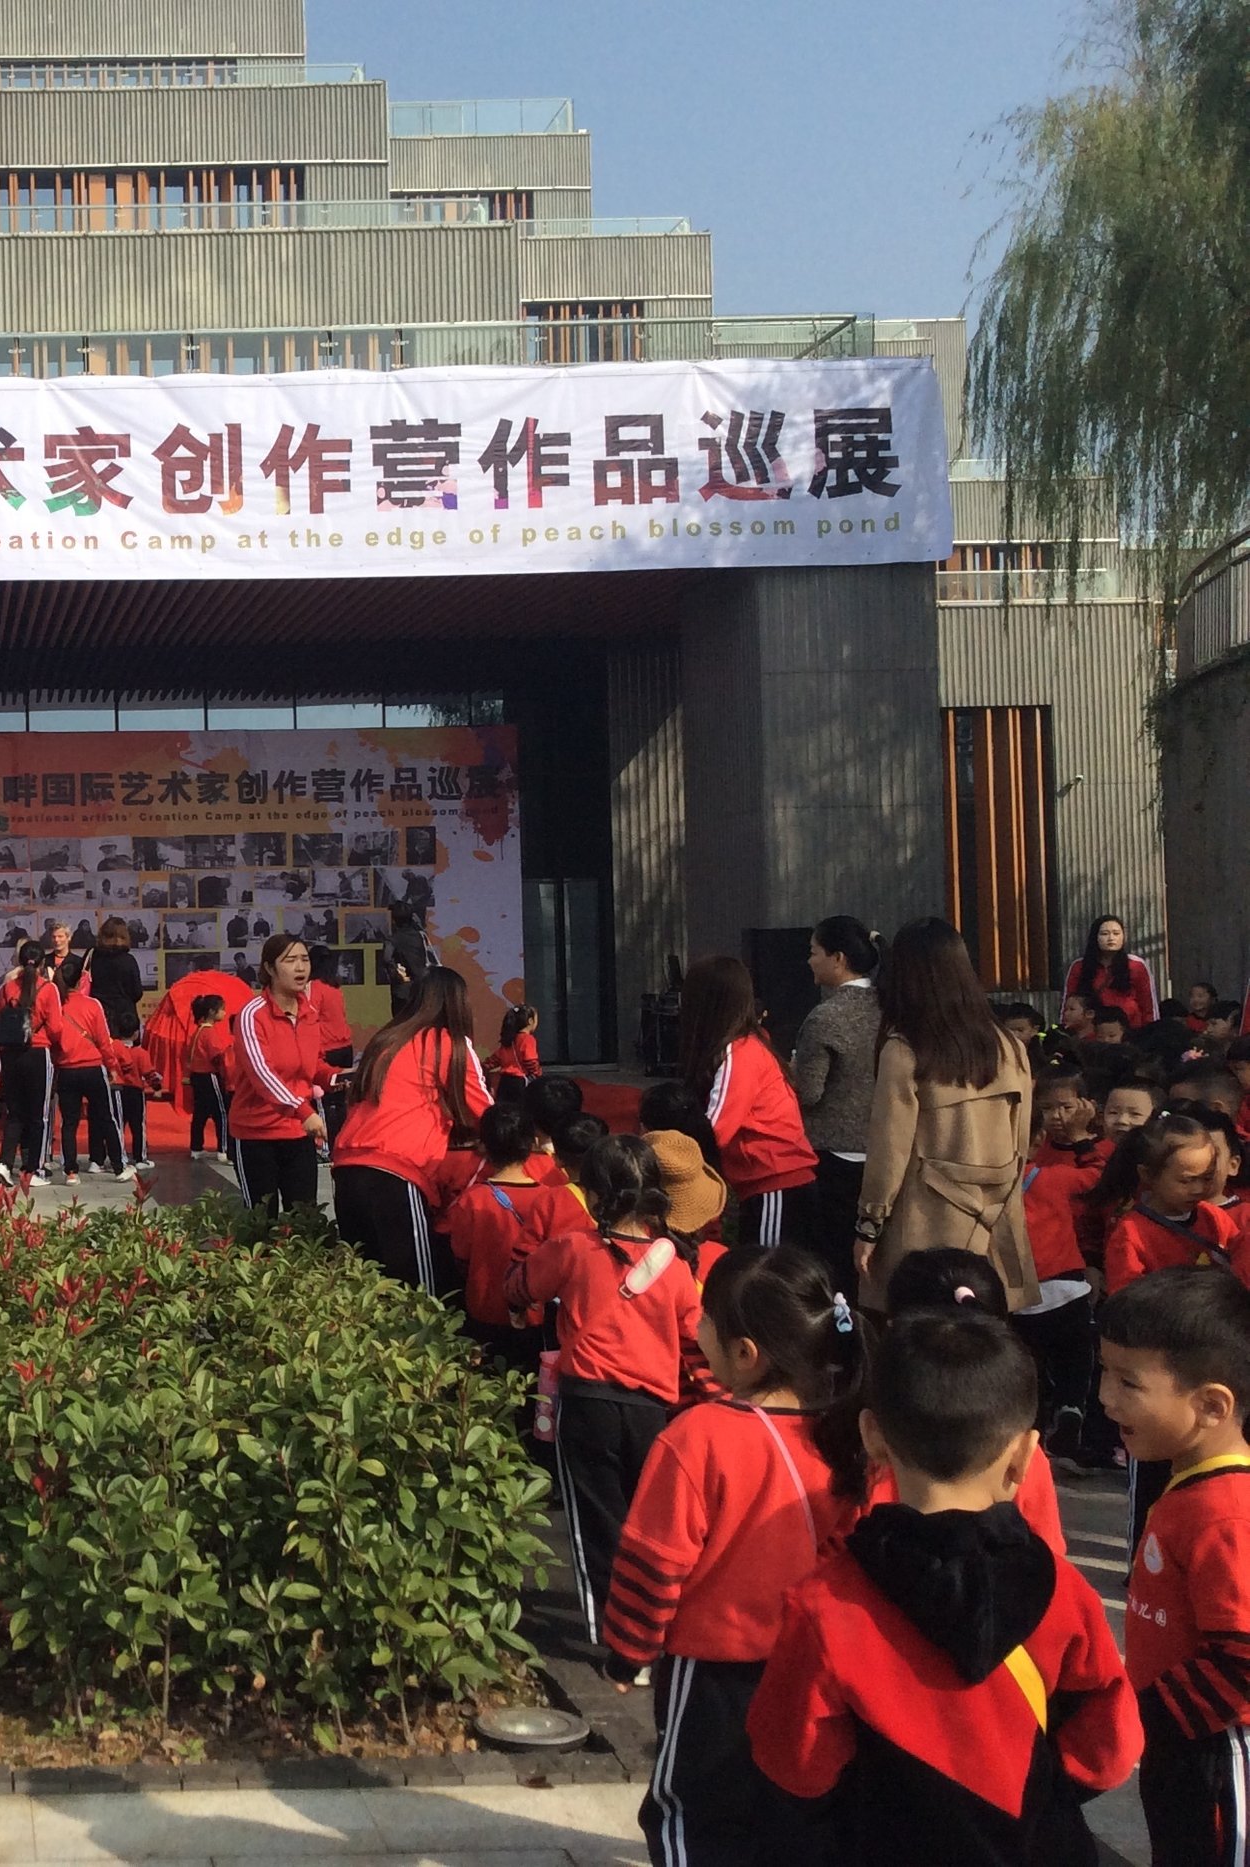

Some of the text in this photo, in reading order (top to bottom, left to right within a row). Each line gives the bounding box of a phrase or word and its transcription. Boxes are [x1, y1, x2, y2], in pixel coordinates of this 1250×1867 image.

[120, 530, 217, 554] Camp
[237, 529, 268, 548] at
[289, 528, 343, 547] the
[365, 526, 447, 550] edge
[468, 524, 501, 545] of
[521, 520, 627, 547] peach
[649, 517, 796, 538] blossom
[816, 512, 901, 535] pond
[139, 811, 199, 822] Creation
[205, 811, 243, 823] Camp
[248, 811, 261, 820] at
[267, 810, 289, 820] the
[295, 809, 328, 822] edge
[334, 808, 349, 819] of
[354, 808, 395, 819] peach
[402, 807, 459, 818] blossom
